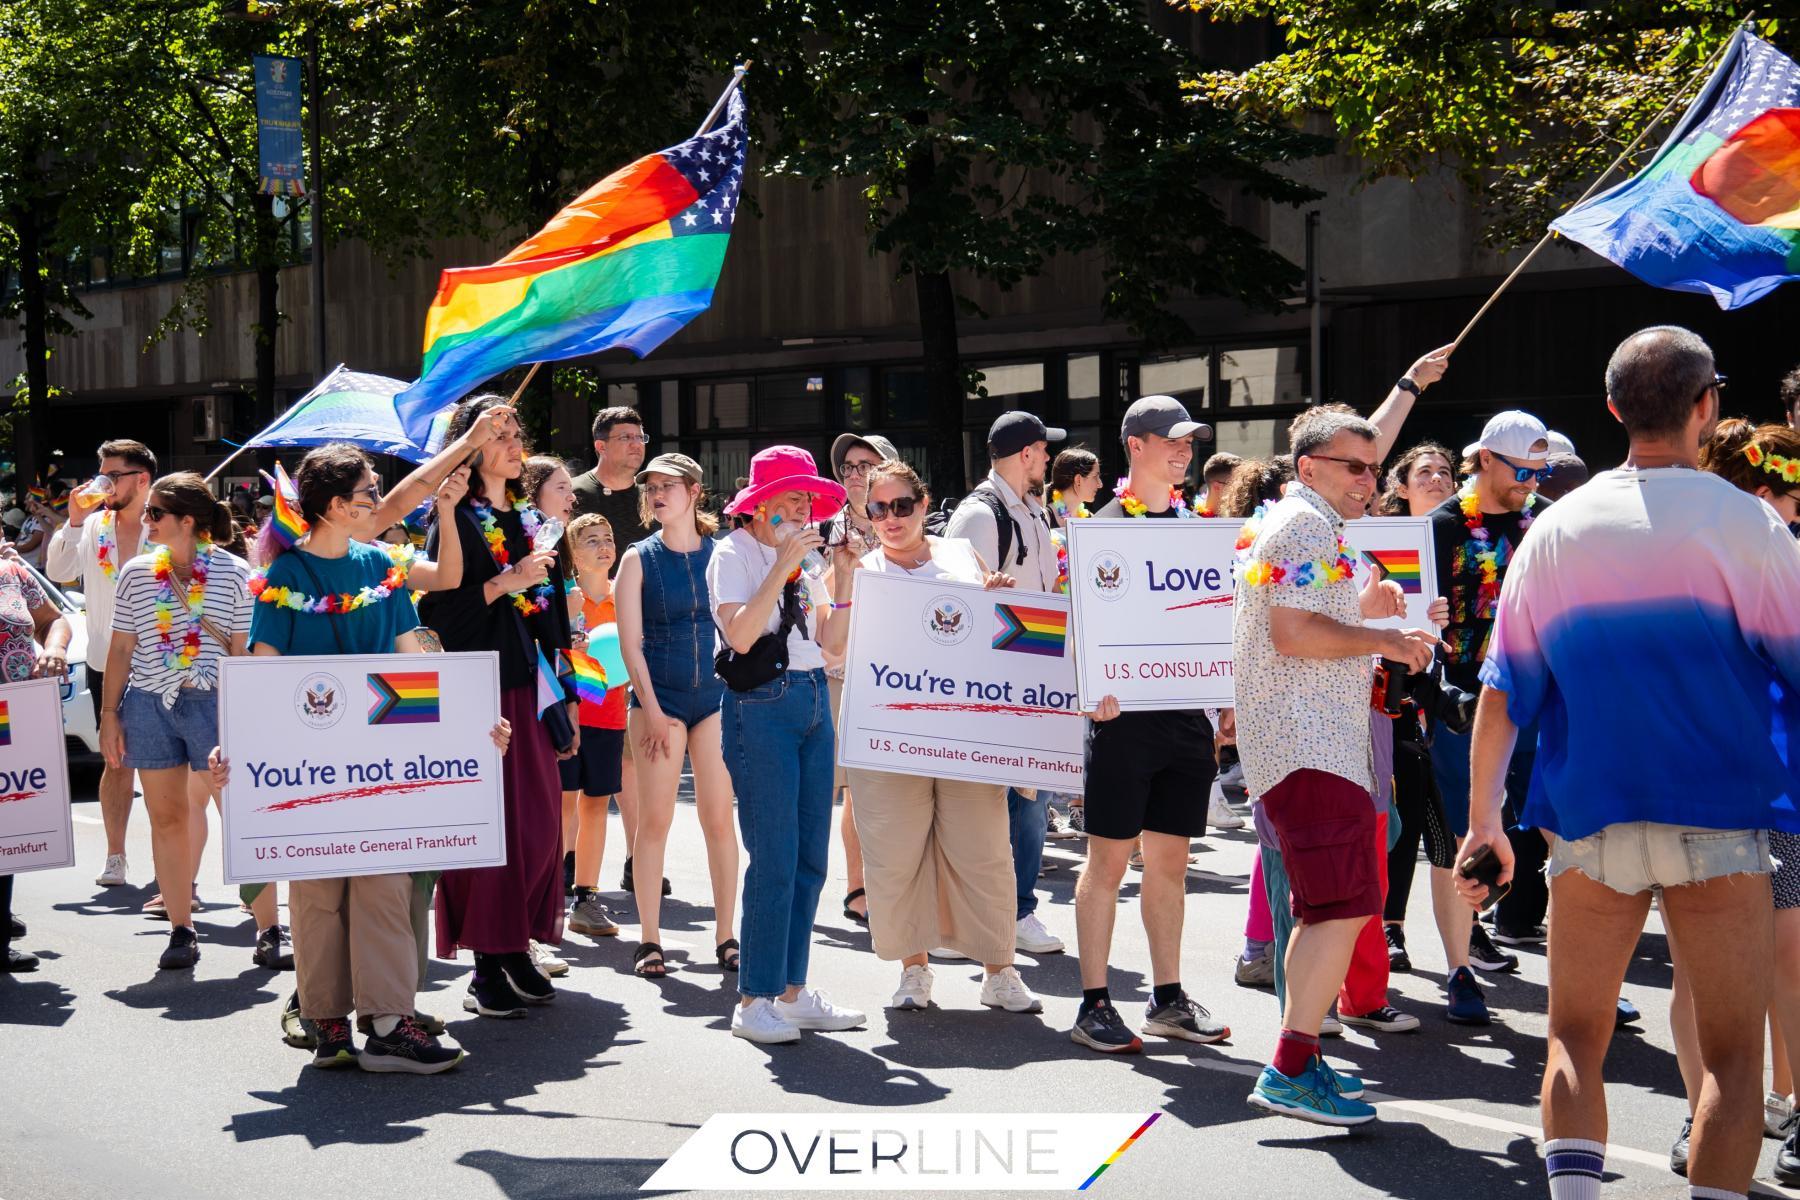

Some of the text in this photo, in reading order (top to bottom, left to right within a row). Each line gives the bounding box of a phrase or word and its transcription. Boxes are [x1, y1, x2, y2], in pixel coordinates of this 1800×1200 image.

[1146, 560, 1221, 591] Love
[870, 662, 956, 696] You're
[965, 680, 1013, 703] not
[1104, 660, 1233, 680] U.S. CONSULAT
[246, 754, 479, 788] You're not alone
[869, 738, 1083, 774] U.S. Consulate General Frankfur
[0, 767, 47, 794] ove
[255, 834, 478, 860] U.S. Consulate General Frankfurt
